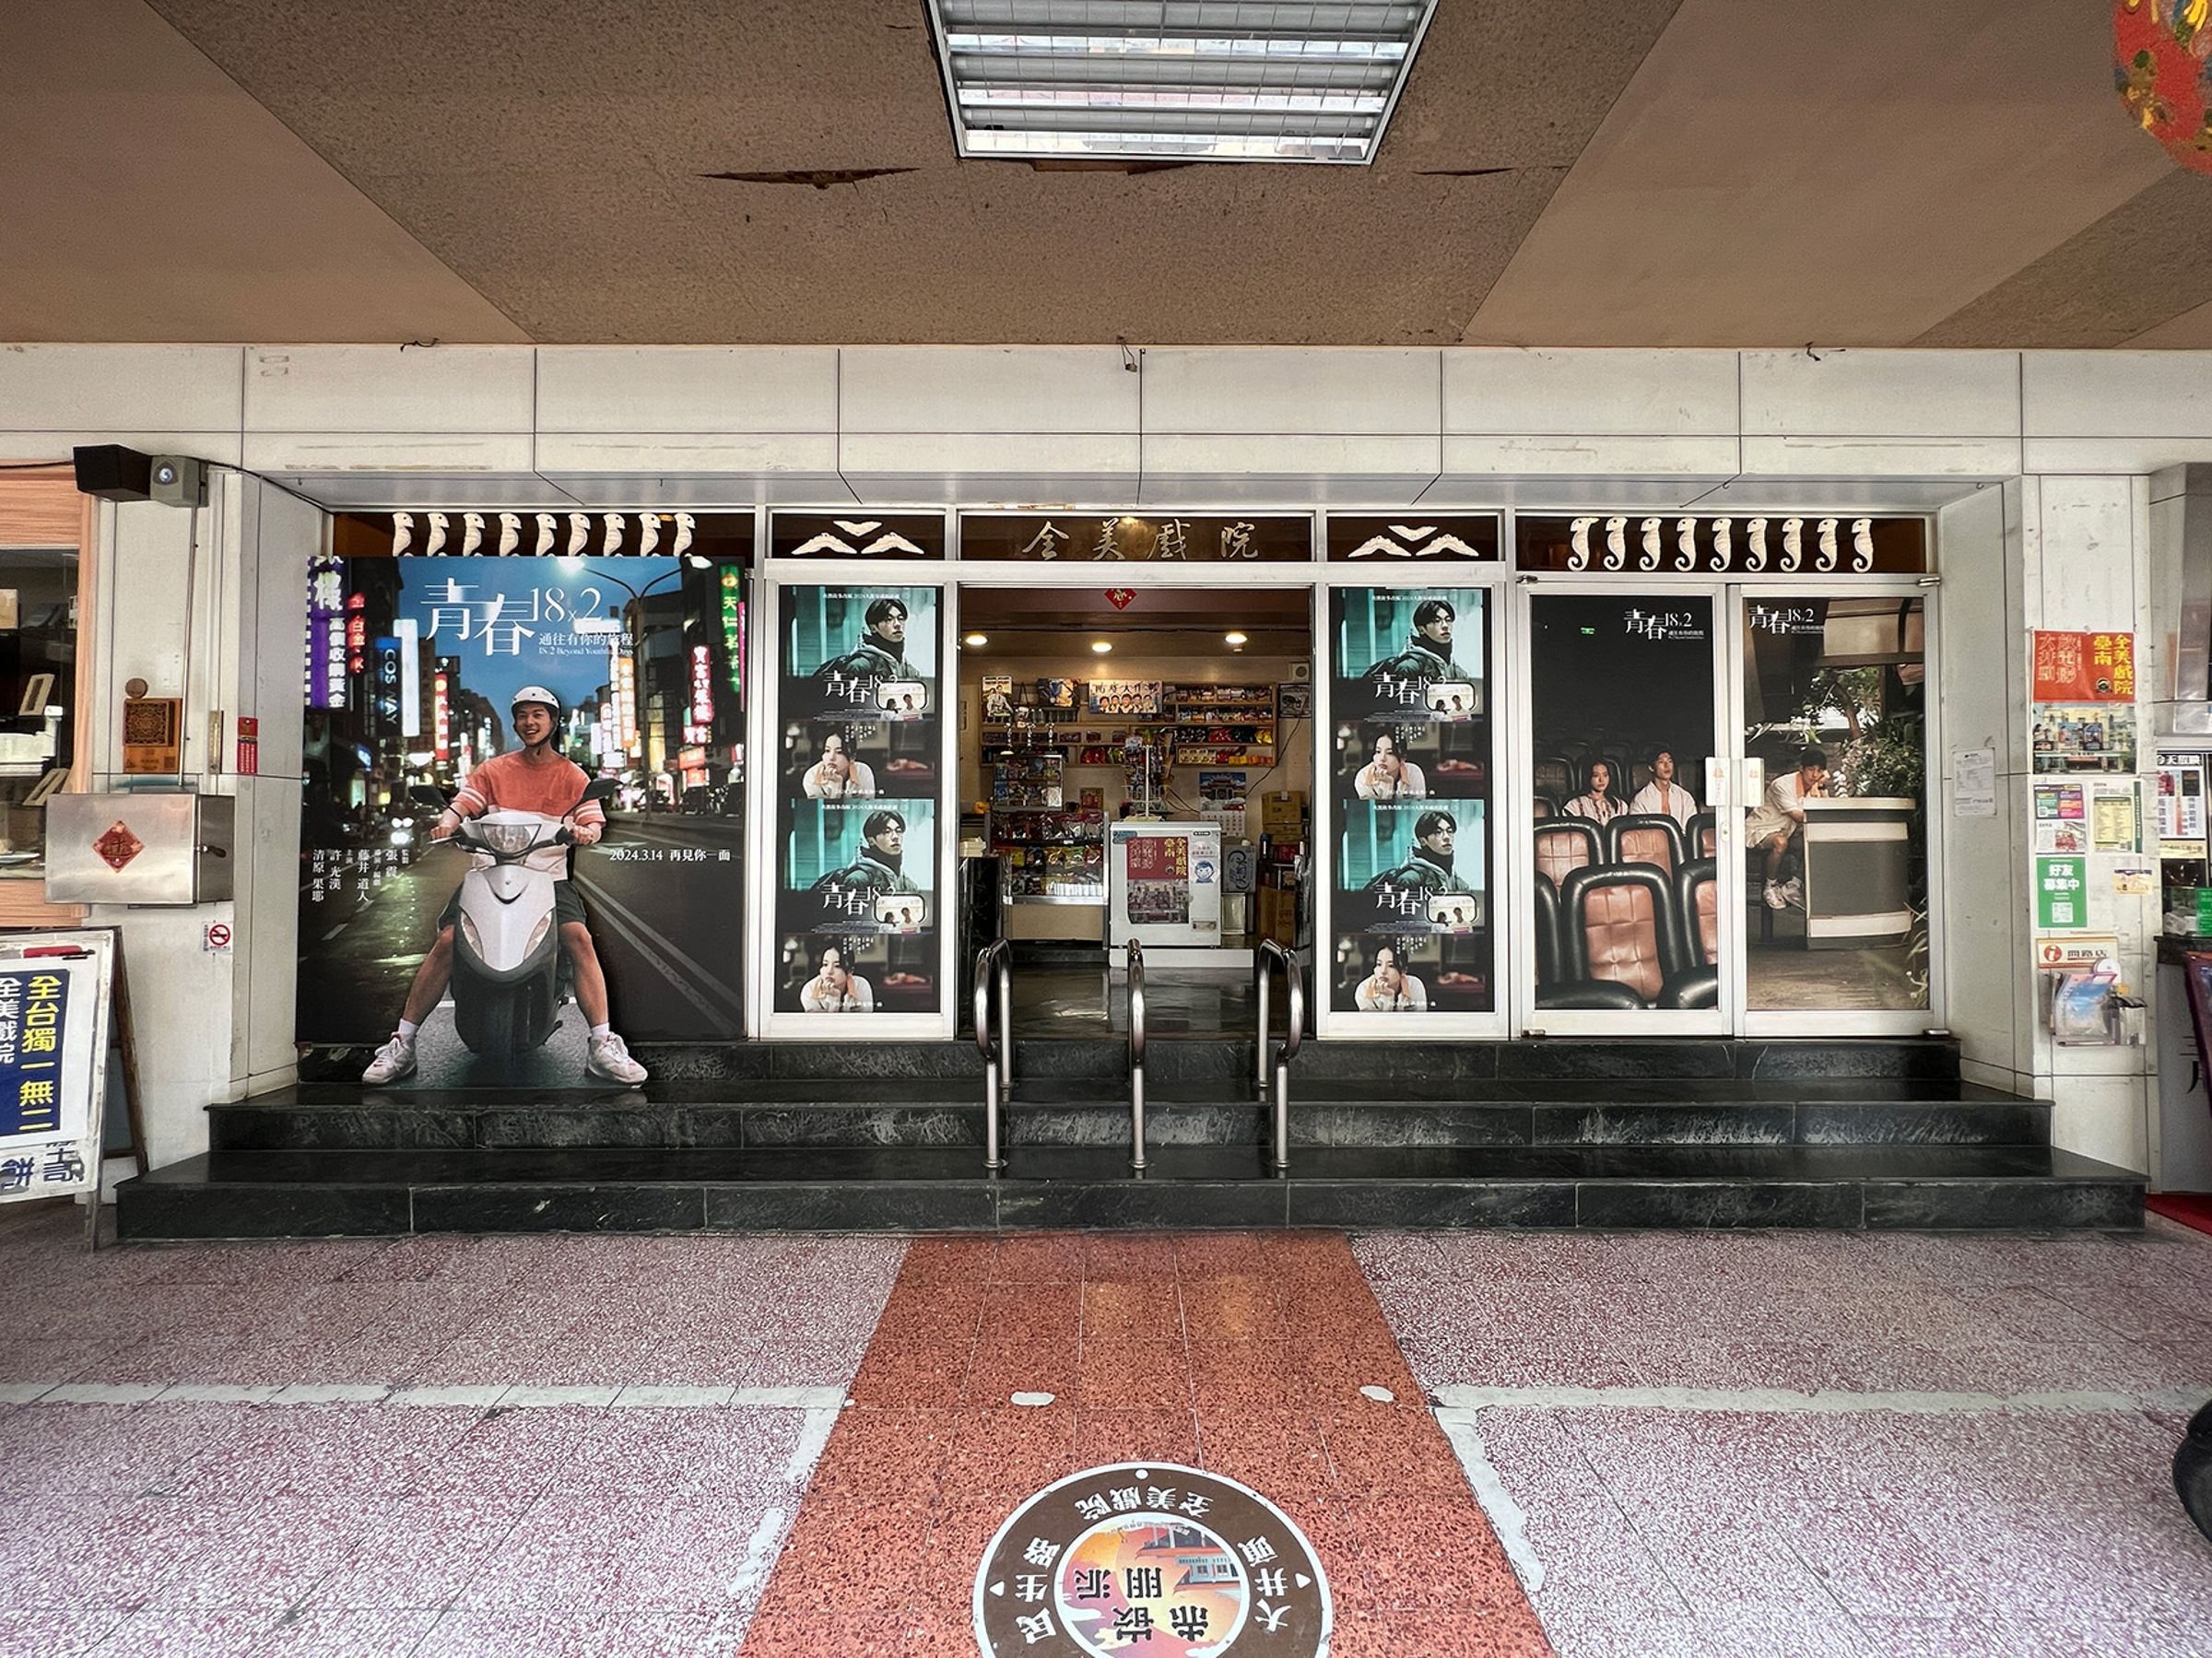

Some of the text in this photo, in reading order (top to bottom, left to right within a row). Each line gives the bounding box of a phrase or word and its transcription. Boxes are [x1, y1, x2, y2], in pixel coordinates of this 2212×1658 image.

[1022, 517, 1258, 560] 全美戲院
[585, 647, 617, 655] Youth
[2113, 634, 2134, 695] 全美戲院
[609, 849, 731, 862] 2024.3.14 再見你一面
[18, 974, 63, 1131] 全台獨一無二
[1075, 1485, 1214, 1521] 全美戲院
[1015, 1535, 1064, 1645] 民生路
[1237, 1535, 1292, 1633] 大井頭
